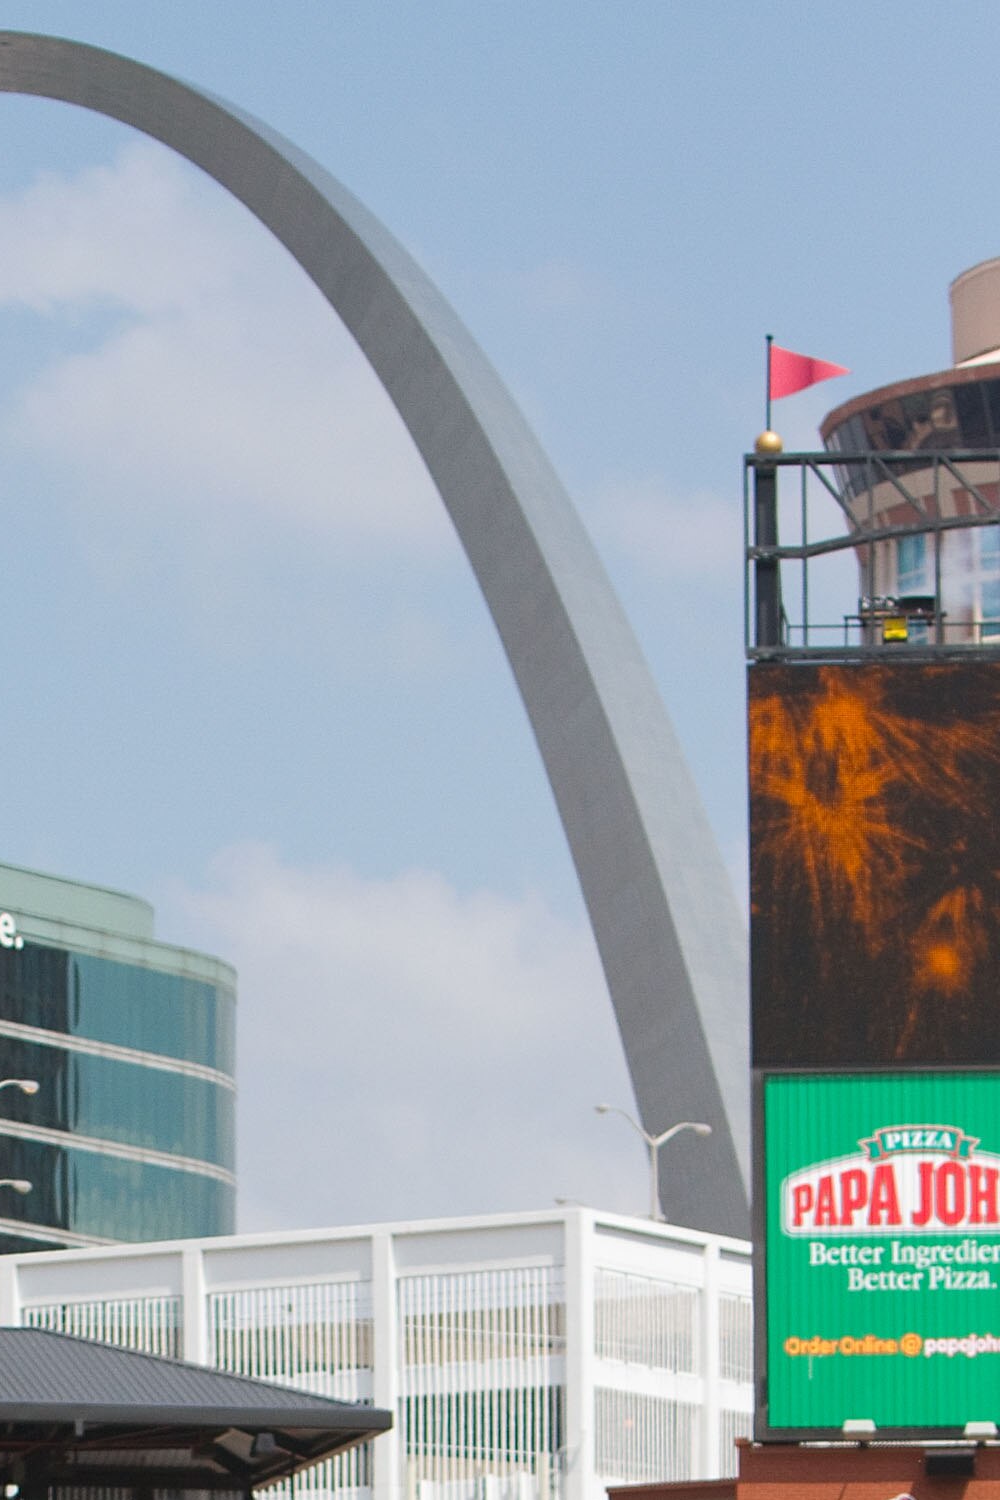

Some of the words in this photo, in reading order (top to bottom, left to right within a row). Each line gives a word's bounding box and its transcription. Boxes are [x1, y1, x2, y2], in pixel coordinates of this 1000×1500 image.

[885, 1130, 953, 1150] PIZZA
[792, 1164, 902, 1227] PAPA
[809, 1242, 884, 1266] Better
[848, 1267, 923, 1291] Better
[929, 1265, 997, 1291] Pizza.
[784, 1336, 838, 1357] Order
[839, 1334, 898, 1356] Online
